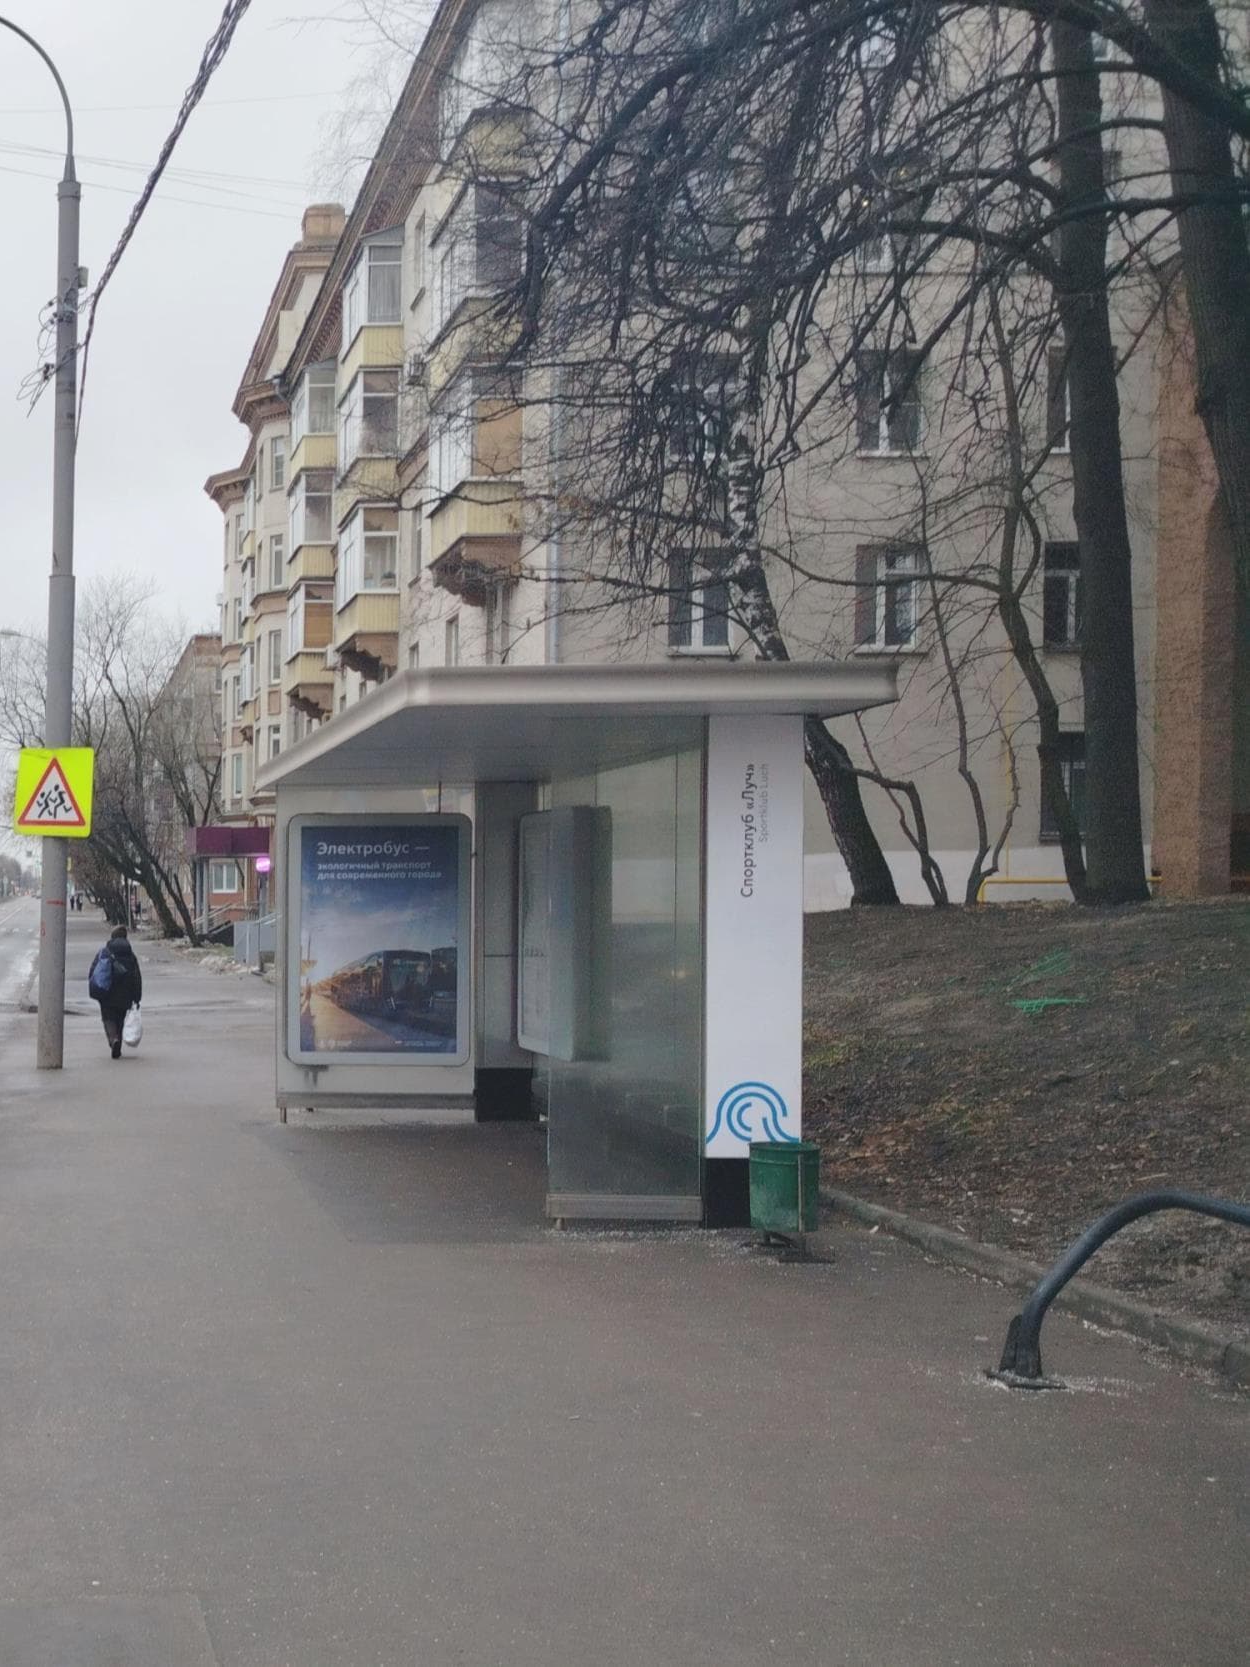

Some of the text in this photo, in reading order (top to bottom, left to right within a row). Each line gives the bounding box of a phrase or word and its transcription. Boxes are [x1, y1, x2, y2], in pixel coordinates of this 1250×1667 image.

[758, 763, 769, 842] Sportklub Luch
[740, 763, 758, 898] Спортклуб «Луч»
[316, 841, 410, 857] Электробус
[317, 861, 432, 873] экологичный транспорт
[317, 870, 443, 881] для современного города
